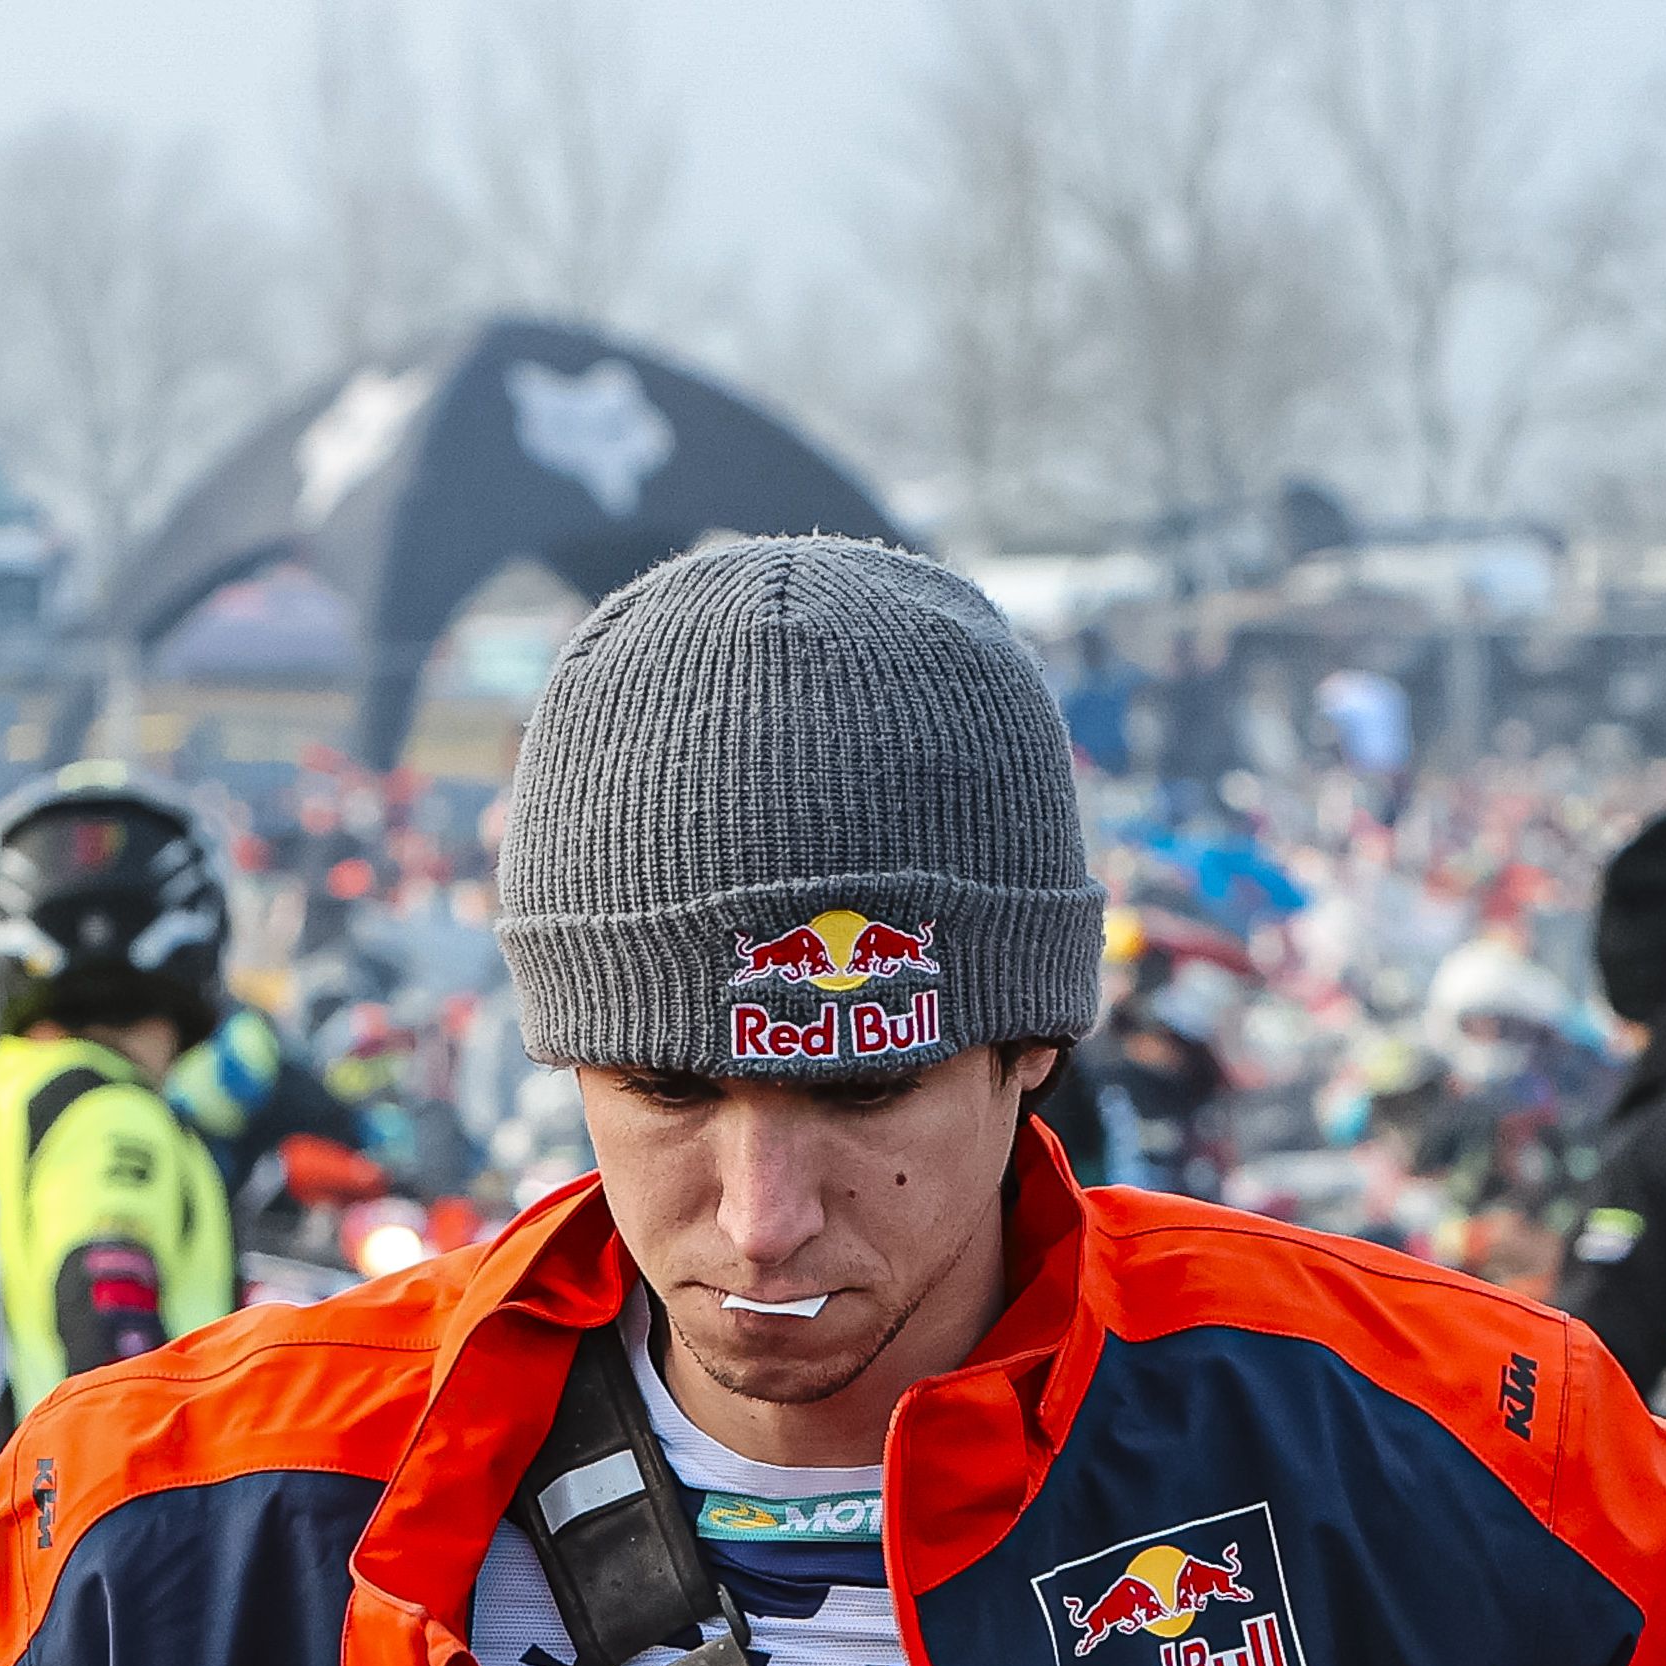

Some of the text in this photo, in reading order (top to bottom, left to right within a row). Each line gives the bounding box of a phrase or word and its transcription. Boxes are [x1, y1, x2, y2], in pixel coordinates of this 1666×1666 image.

[731, 991, 939, 1058] Red Bull
[1498, 1352, 1537, 1442] KTM
